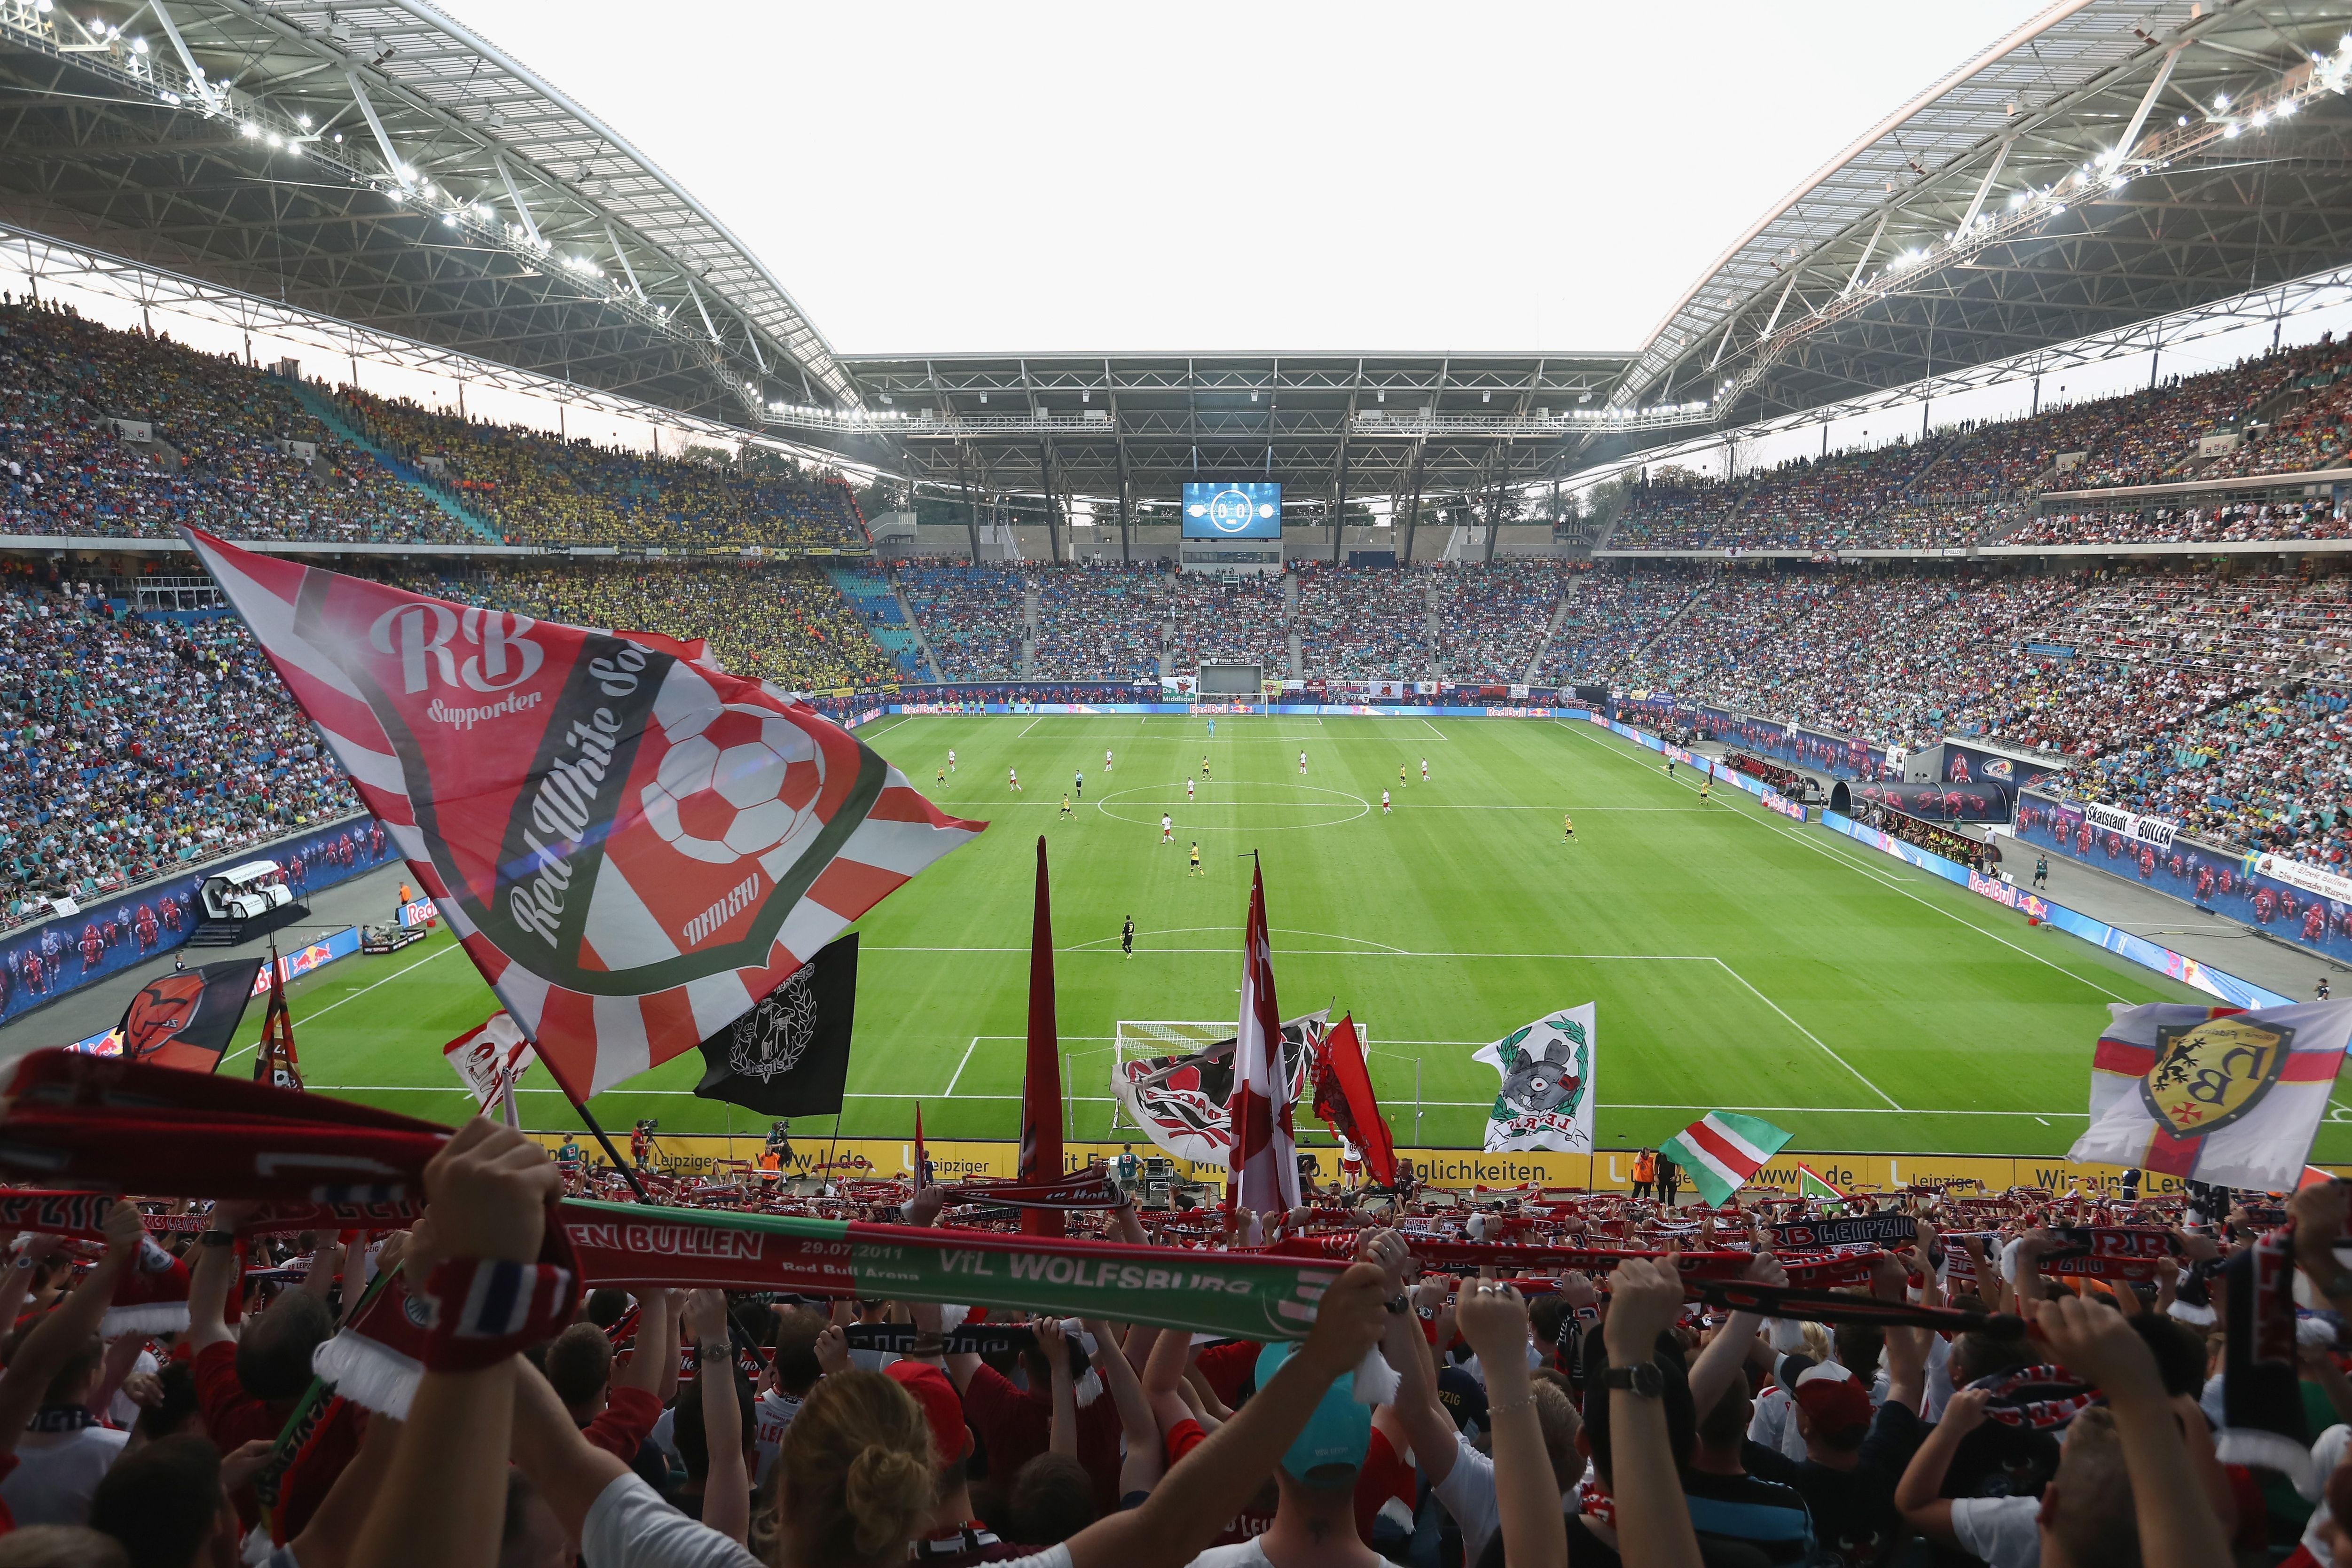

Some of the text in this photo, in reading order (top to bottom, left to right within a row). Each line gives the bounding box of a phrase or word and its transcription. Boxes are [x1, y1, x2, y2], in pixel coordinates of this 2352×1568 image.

[1218, 503, 1245, 518] 0 0
[369, 603, 544, 694] RB
[427, 691, 542, 730] Supporter
[533, 707, 623, 843] White
[2087, 806, 2175, 845] Skatstadt BULLEN
[510, 829, 572, 949] Red
[2278, 871, 2351, 901] Die gerade Kurve
[2321, 875, 2348, 889] Bullen
[1064, 1152, 1078, 1172] it
[626, 1224, 765, 1260] BULLEN
[800, 1240, 903, 1260] 29.07.2011
[1771, 1227, 1815, 1247] RB
[783, 1262, 920, 1281] Red Bull Arena
[940, 1248, 1254, 1294] VfL WOLFSBURG
